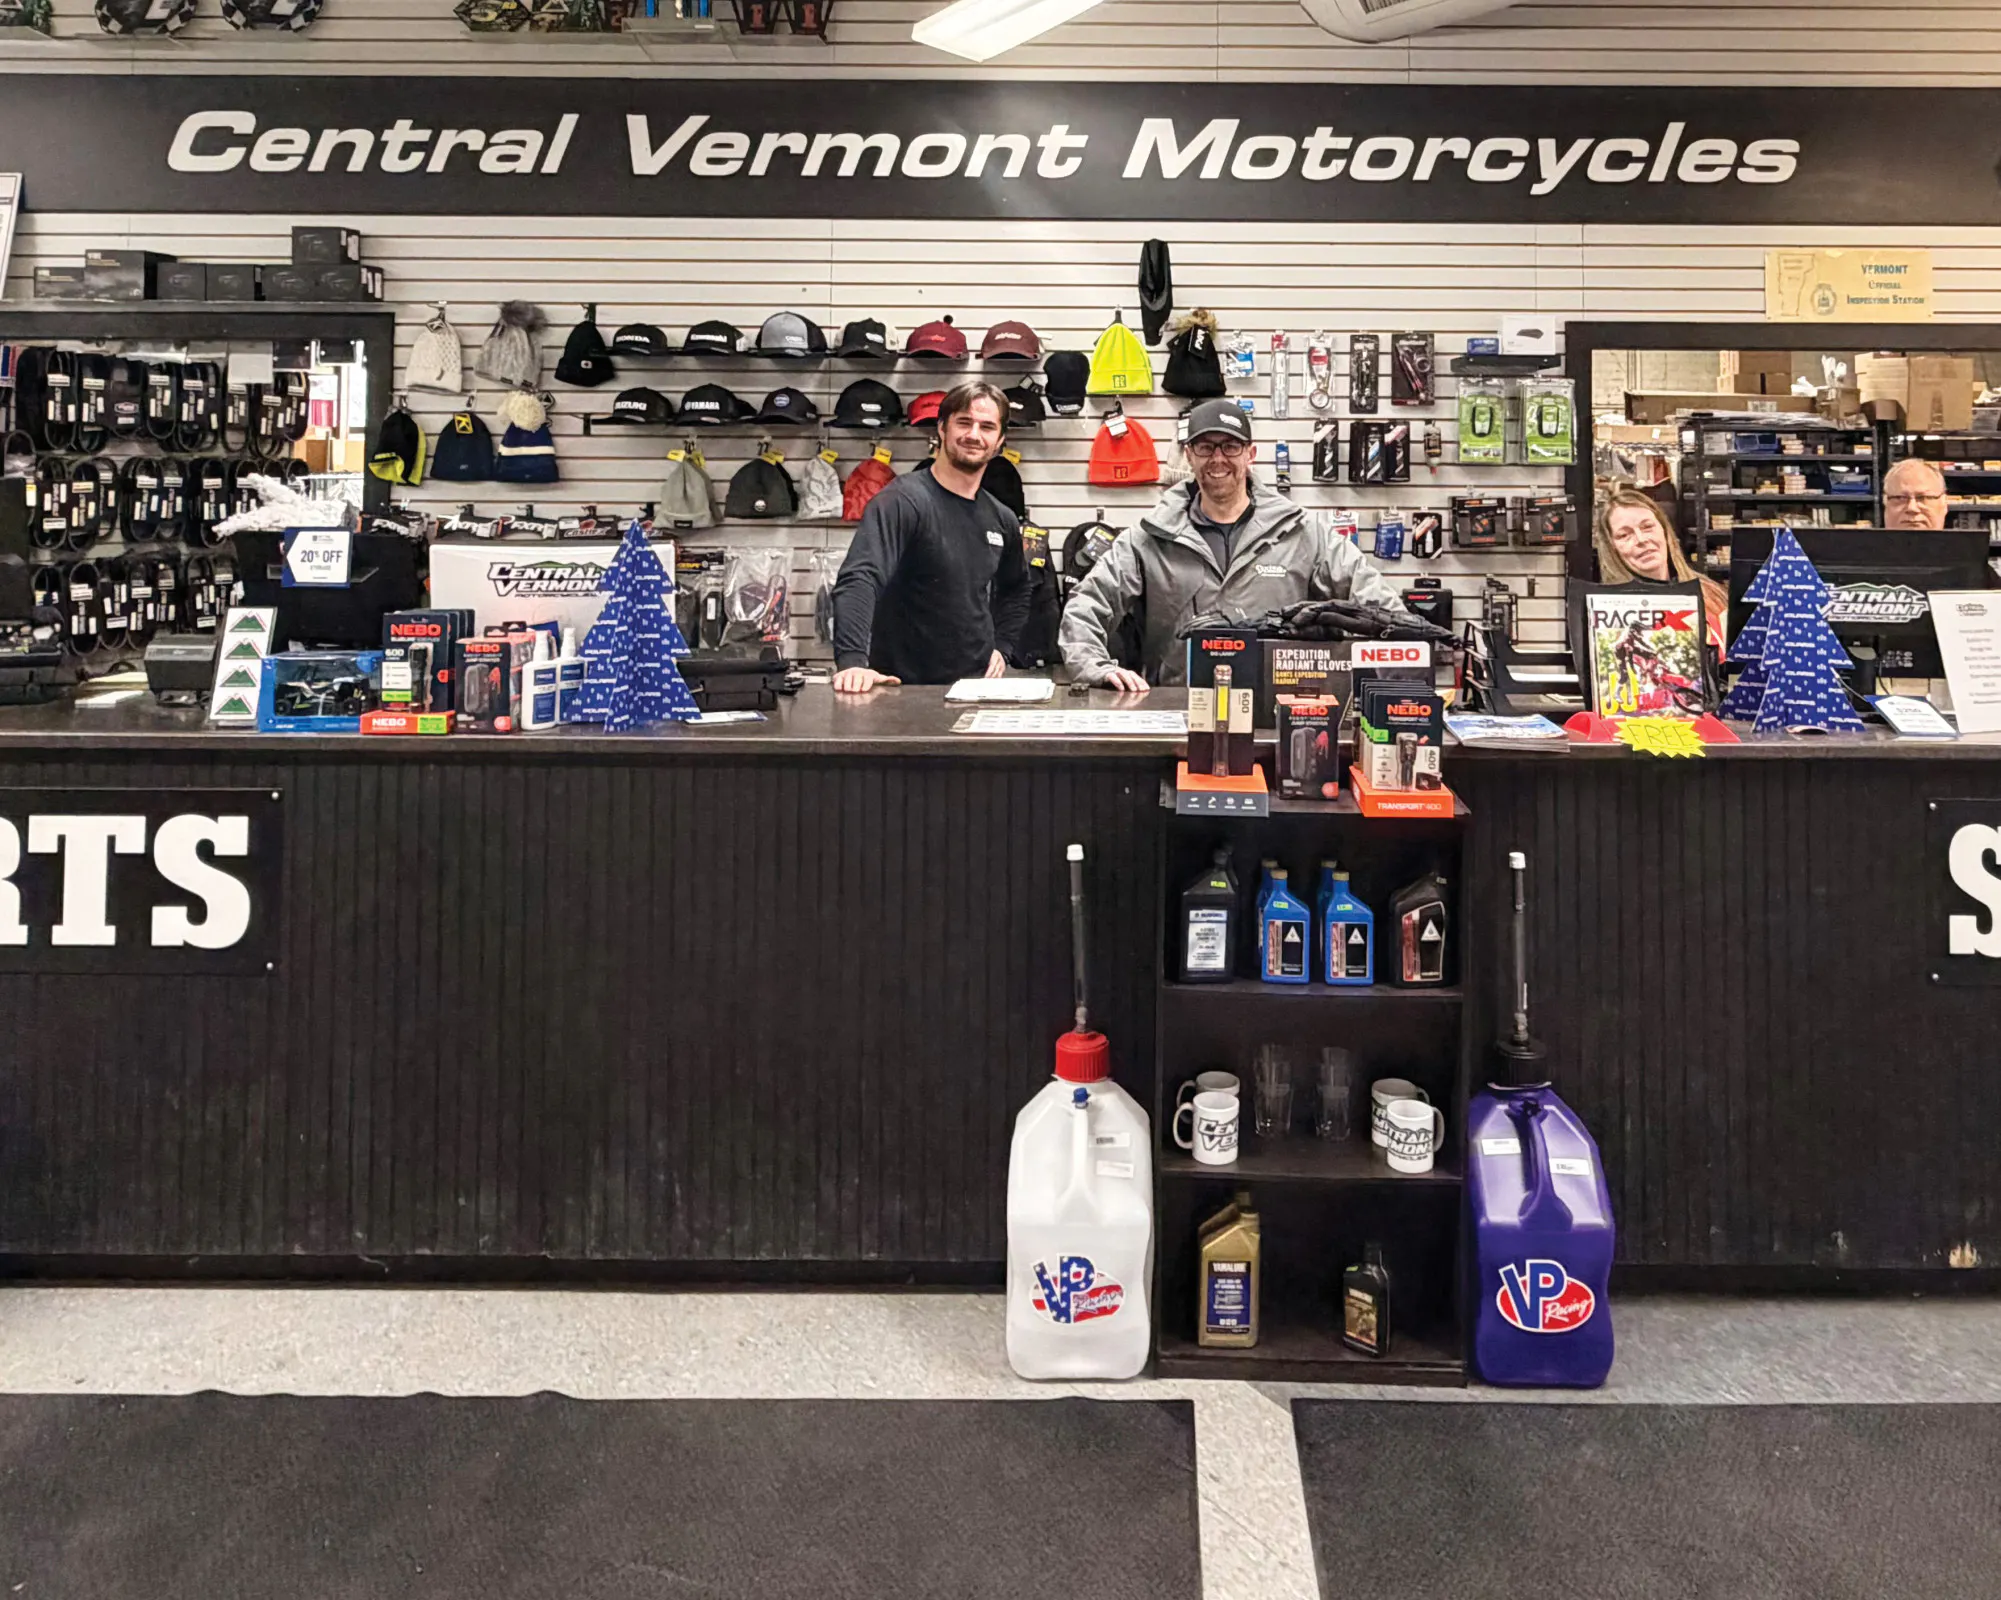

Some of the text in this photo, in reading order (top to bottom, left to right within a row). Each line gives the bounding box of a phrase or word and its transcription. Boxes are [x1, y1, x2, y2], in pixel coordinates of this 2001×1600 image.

[167, 110, 1799, 195] Central Vermont Motorcycles
[1861, 264, 1909, 274] VERMONT
[322, 550, 343, 563] OFF
[488, 562, 602, 580] CENTRAL
[494, 579, 600, 597] VERMON
[1827, 590, 1912, 603] ENTRAL
[1816, 602, 1926, 616] VERMONT
[390, 624, 442, 637] NEBO
[465, 643, 501, 653] NEBO
[1201, 639, 1246, 650] NEBO
[385, 648, 405, 657] 600
[1275, 648, 1331, 660] EXPEDITION
[1361, 648, 1421, 661] NEBO
[1275, 660, 1353, 672] RADIANT GLOVES
[1291, 705, 1329, 717] NEBO
[1387, 703, 1432, 716] NEBO
[372, 717, 407, 727] NEBO
[1627, 724, 1696, 747] FREE
[1428, 749, 1437, 770] 400
[1377, 802, 1442, 811] TRANSPORT 400
[0, 814, 251, 950] TS
[1201, 1134, 1238, 1151] VE
[1031, 1252, 1097, 1325] VP
[1499, 1259, 1568, 1330] VP
[1544, 1298, 1593, 1323] Racing
